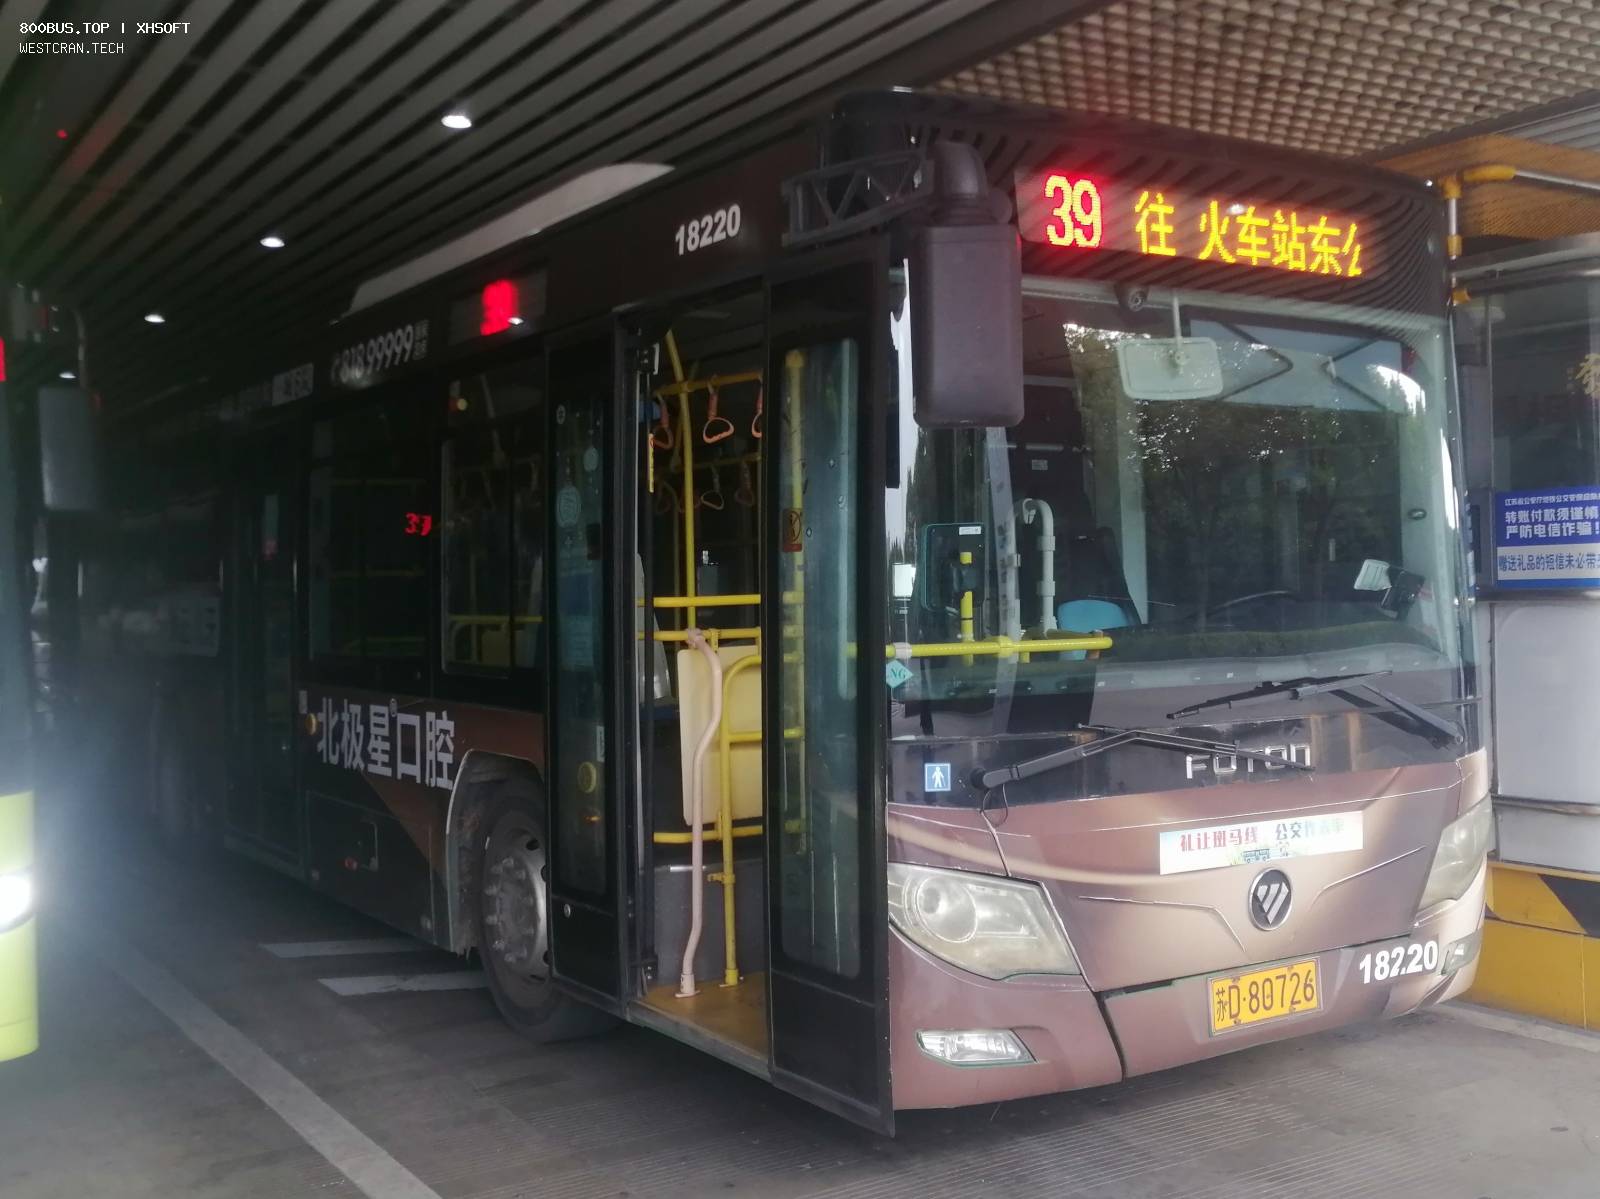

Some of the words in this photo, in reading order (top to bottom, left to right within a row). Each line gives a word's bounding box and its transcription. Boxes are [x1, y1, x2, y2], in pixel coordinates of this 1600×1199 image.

[675, 203, 741, 256] 18220
[1045, 175, 1102, 248] 39
[1134, 191, 1177, 257] 往
[1505, 506, 1599, 524] 转账付款须谨慎
[1499, 552, 1600, 572] 赠送礼品的短信未必带
[317, 697, 455, 790] 北极星口腔
[1180, 826, 1259, 852] 礼让斑马线
[1359, 940, 1438, 984] 18220
